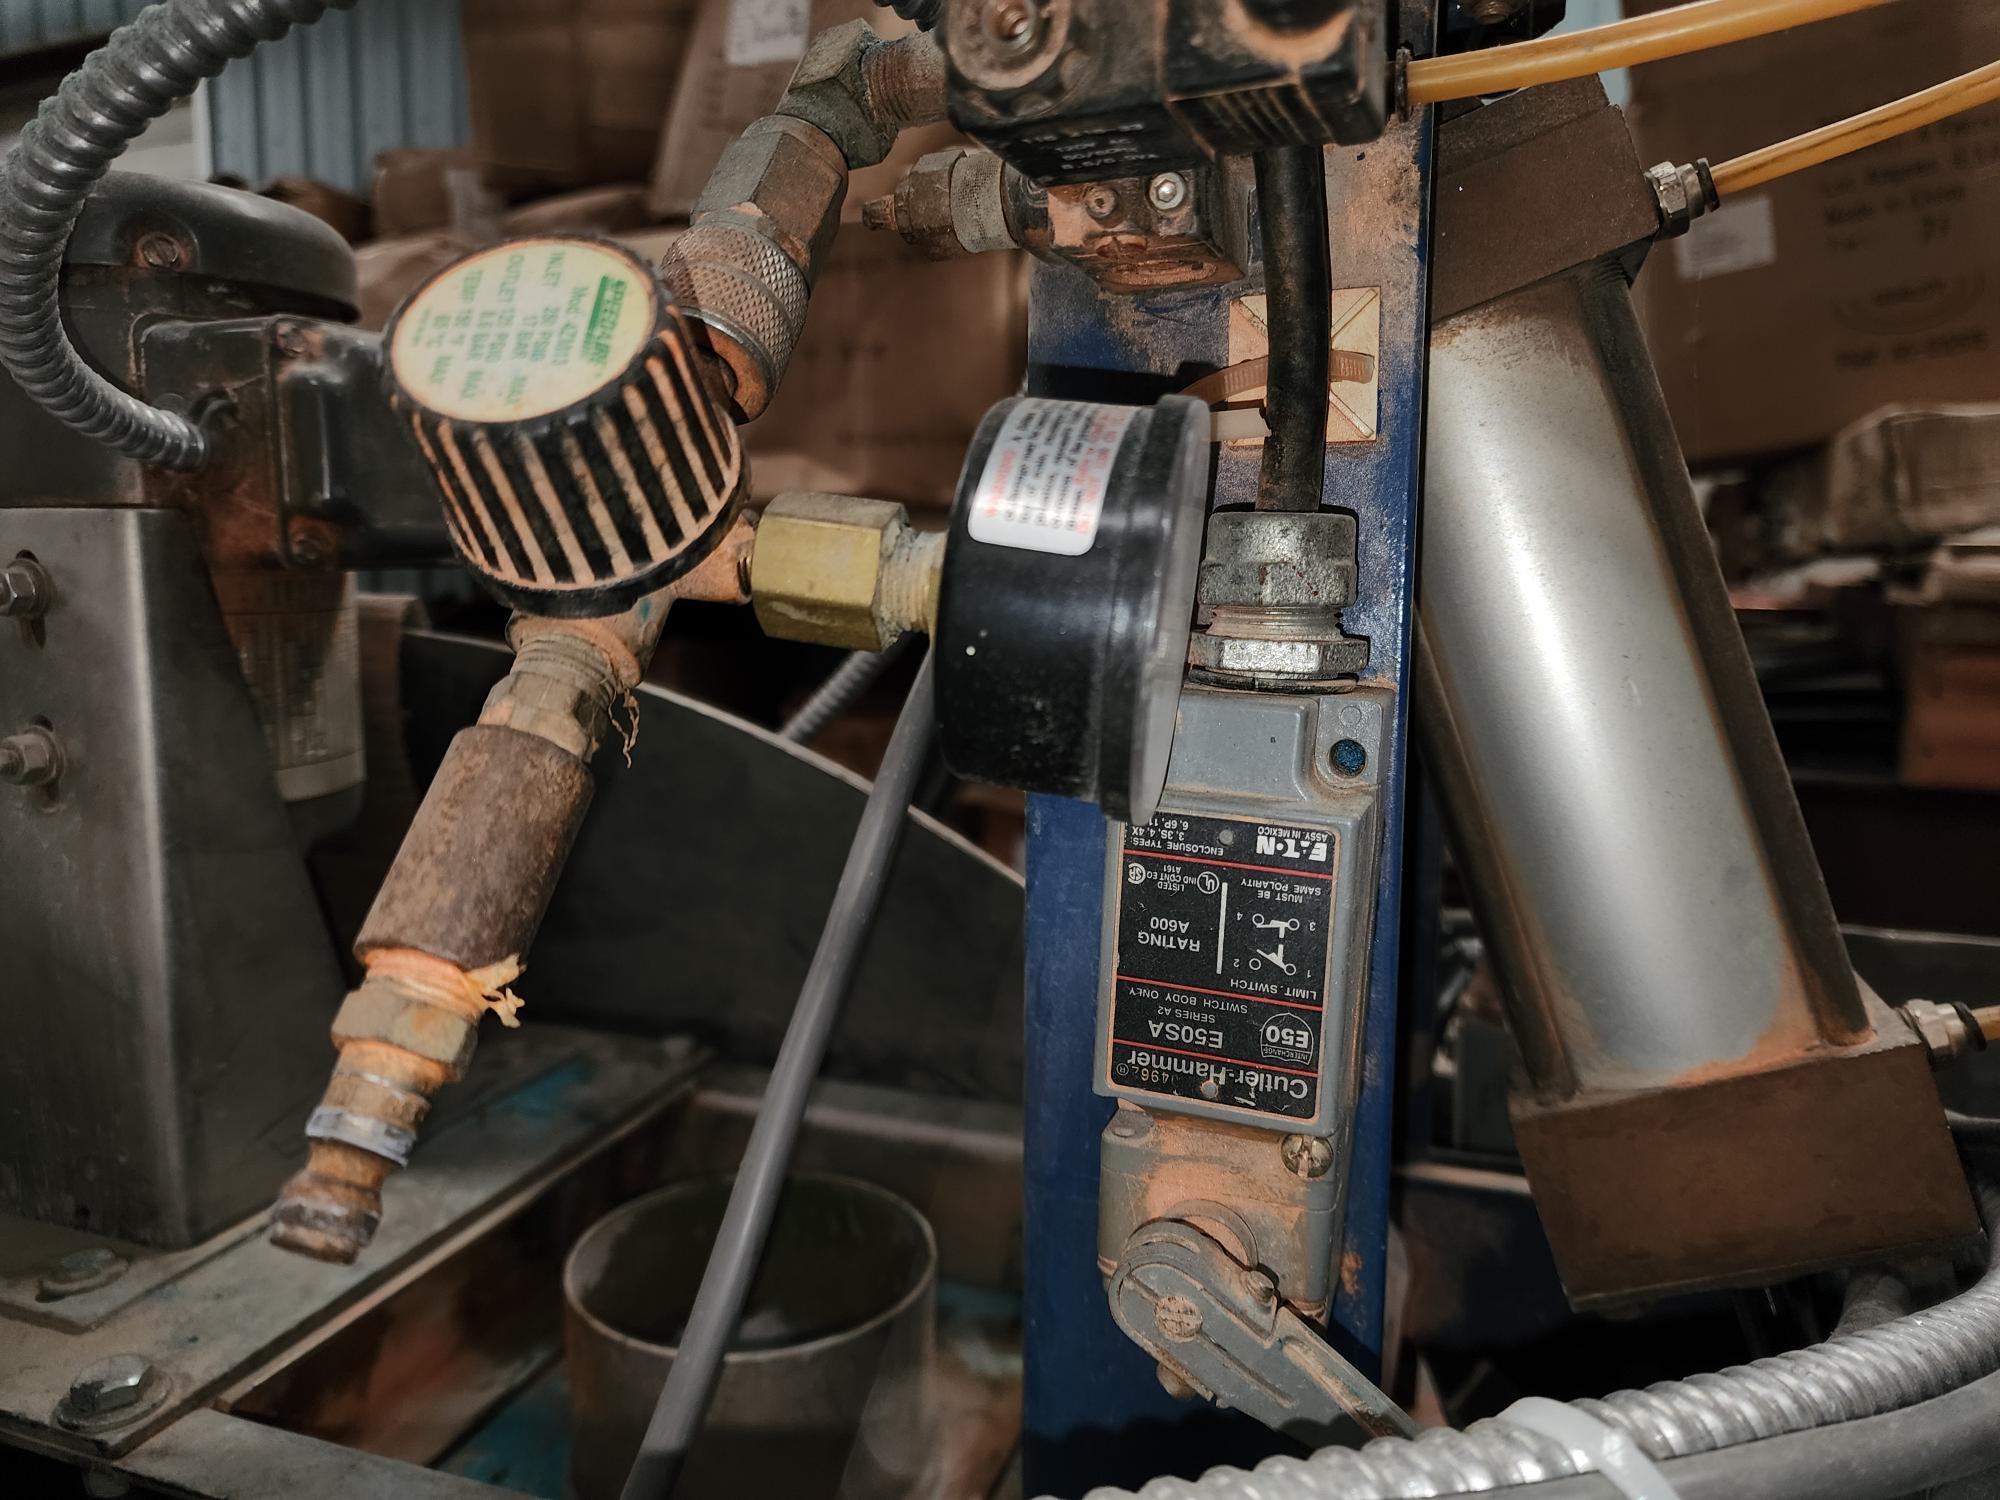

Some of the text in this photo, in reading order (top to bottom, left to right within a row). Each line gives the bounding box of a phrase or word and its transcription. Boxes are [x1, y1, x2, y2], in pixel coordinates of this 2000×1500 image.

[498, 254, 524, 303] OUTLET
[1180, 820, 1188, 830] 6,
[1175, 830, 1184, 841] 3,
[1257, 826, 1328, 842] ASSY. IN MEXICO
[1166, 842, 1224, 856] ENCLOSURE
[1157, 881, 1184, 892] LISTED
[1182, 875, 1197, 885] IND
[1240, 878, 1321, 896] SAME POLARITY
[1257, 890, 1302, 903] MUST BE
[1150, 916, 1190, 932] A600
[1236, 912, 1243, 920] 4
[1309, 922, 1316, 931] 3
[1137, 931, 1200, 952] RATING
[1233, 958, 1240, 968] 2
[1306, 969, 1312, 978] 1
[1230, 978, 1317, 1000] LIMIT SWITCH
[1129, 986, 1248, 1014] SWITCH BODY ONLY
[1157, 1006, 1216, 1024] SERIES A2
[1148, 1020, 1222, 1049] E50SA
[1265, 1025, 1309, 1049] E50
[1127, 1050, 1308, 1099] Cutler-Hammer
